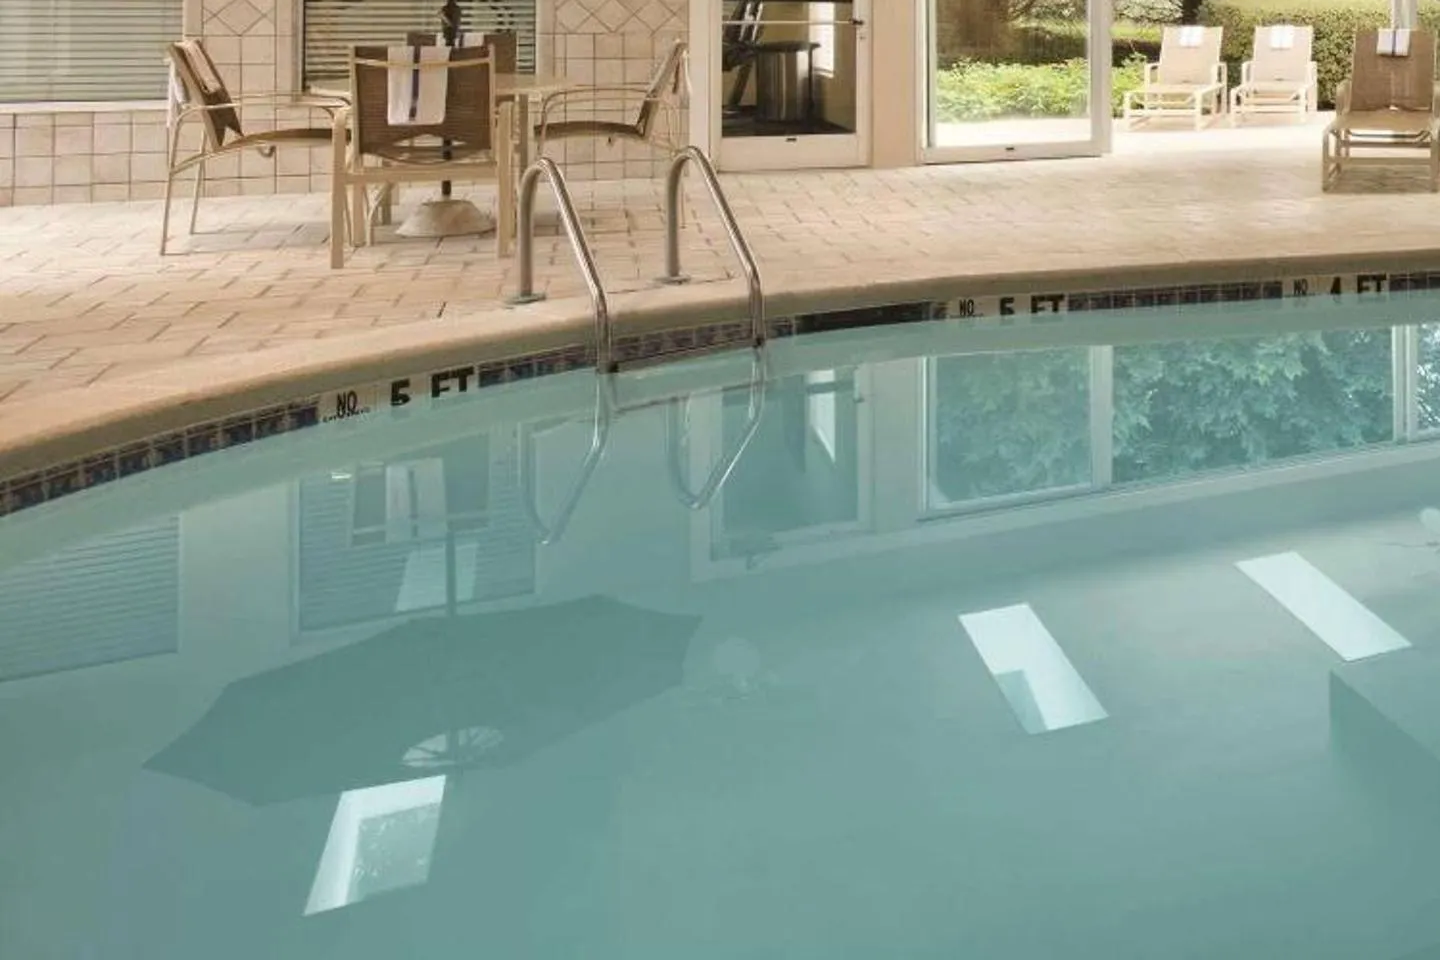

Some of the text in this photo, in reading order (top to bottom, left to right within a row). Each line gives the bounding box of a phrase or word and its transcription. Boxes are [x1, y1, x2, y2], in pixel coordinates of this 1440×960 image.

[1357, 274, 1386, 294] FT
[959, 299, 974, 316] NO
[1030, 293, 1065, 313] FT
[390, 366, 474, 407] 5 FT
[336, 390, 357, 418] NO
